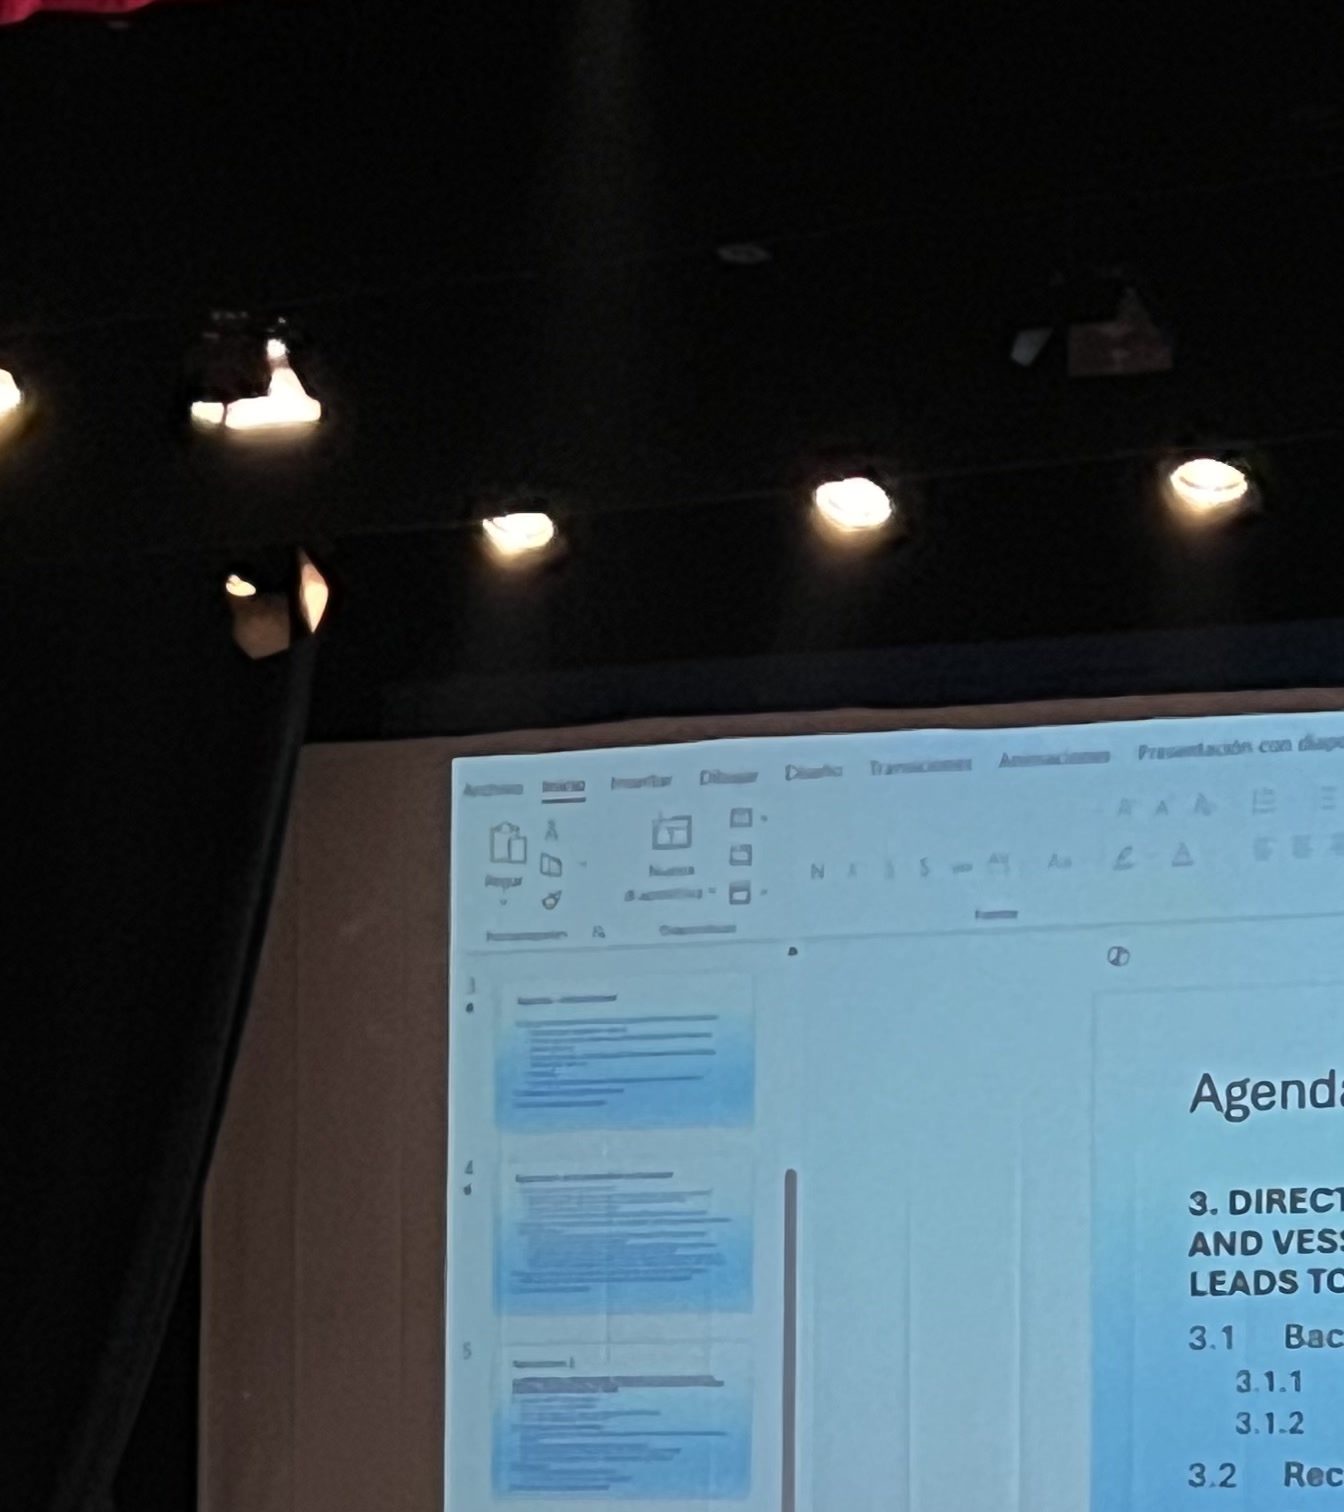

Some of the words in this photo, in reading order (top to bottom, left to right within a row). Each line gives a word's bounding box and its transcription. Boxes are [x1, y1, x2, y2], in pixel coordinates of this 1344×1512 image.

[1188, 1190, 1218, 1217] 3.
[1187, 1230, 1263, 1258] AND
[1190, 1269, 1299, 1297] LEADS
[1188, 1325, 1233, 1351] 3.1
[1236, 1369, 1301, 1393] 3.1.1
[1235, 1411, 1304, 1435] 3.1.2
[1188, 1462, 1237, 1488] 3.2
